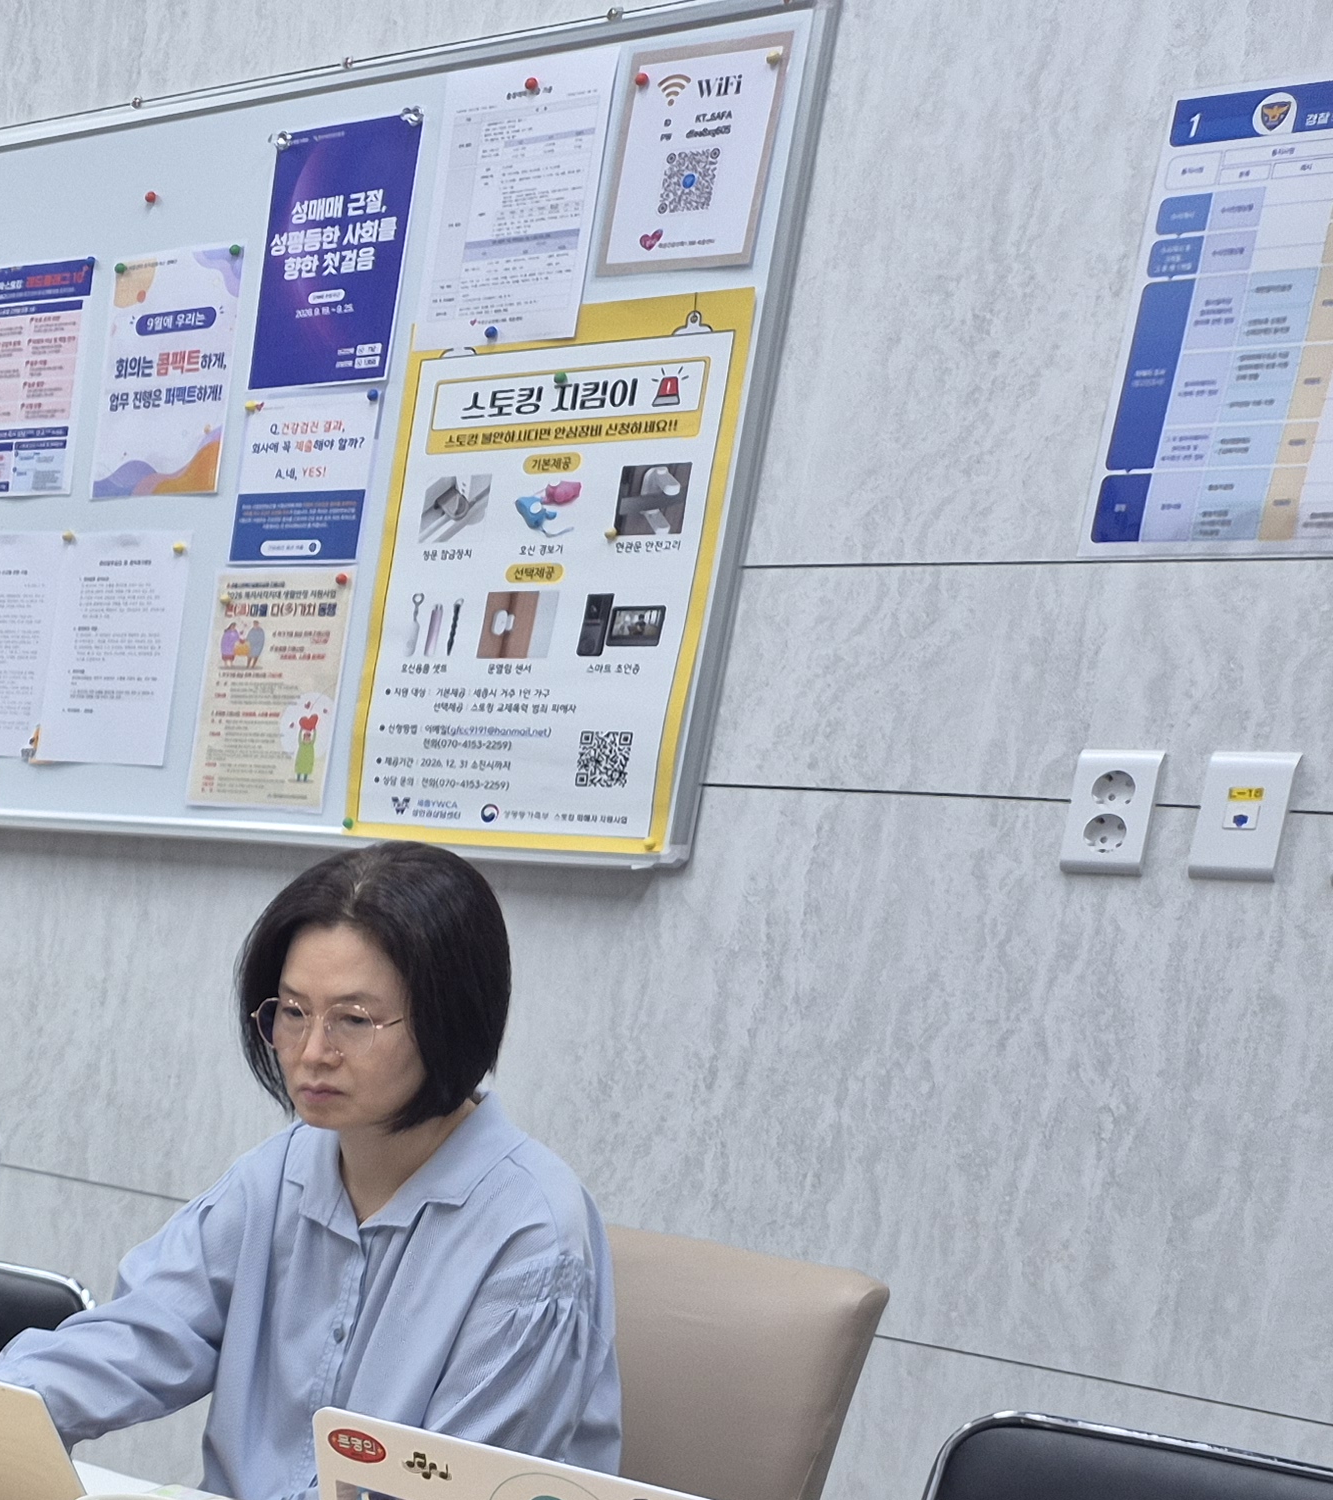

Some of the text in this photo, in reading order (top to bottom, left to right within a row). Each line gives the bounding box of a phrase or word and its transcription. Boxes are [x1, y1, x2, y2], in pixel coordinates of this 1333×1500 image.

[697, 74, 743, 98] WiFi
[1189, 112, 1202, 138] 1
[1305, 111, 1330, 127] 경찰
[291, 188, 387, 224] 성매매 근절,
[270, 216, 397, 256] 성평등한 사회를
[283, 246, 375, 281] 향한 첫걸음
[146, 311, 206, 331] 9월에 우리는
[114, 349, 227, 380] 회의는 콤팩트하게,
[109, 384, 222, 412] 업무 진행은 퍼펙트하게!
[460, 378, 639, 420] 스토킹 지킴이
[444, 418, 679, 449] 스토킹 불안하시다면 안심장비 신청하세요!!
[252, 442, 279, 454] 회사에
[283, 441, 291, 453] 꼭
[338, 437, 365, 451] 할까?
[302, 466, 327, 477] YES!
[531, 456, 573, 471] 기본제공
[519, 543, 564, 556] 호신 경보기
[644, 539, 681, 552] 안전고리
[513, 565, 556, 580] 선택제공
[514, 663, 532, 675] 센서
[586, 663, 612, 674] 스마트
[435, 688, 466, 699] 기본제공
[500, 688, 516, 698] 거주
[470, 703, 493, 714] 스토킹
[459, 759, 468, 768] 31
